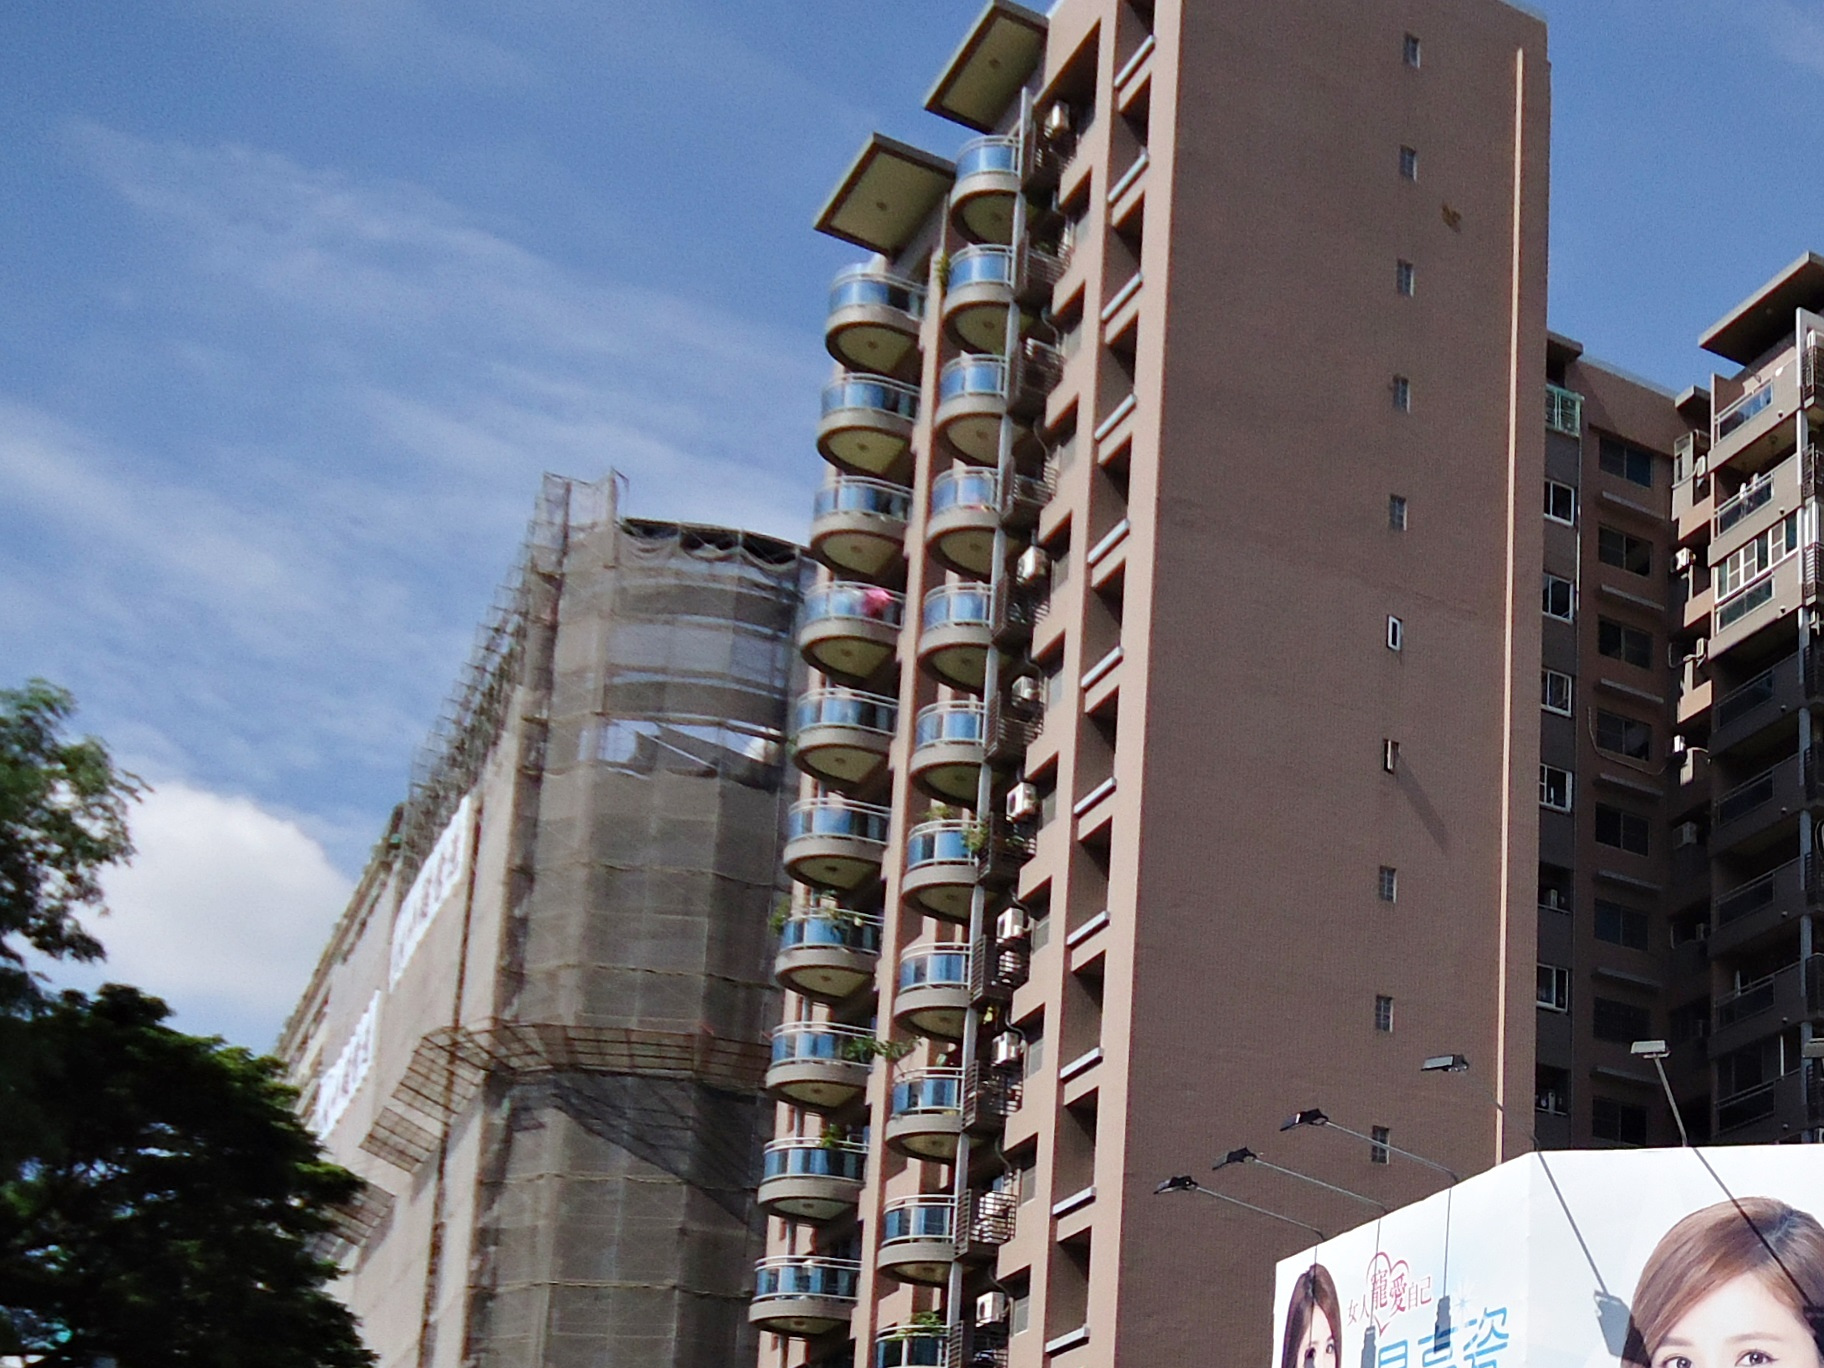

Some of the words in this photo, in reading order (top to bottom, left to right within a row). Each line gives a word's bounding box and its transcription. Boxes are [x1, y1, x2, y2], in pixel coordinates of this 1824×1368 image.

[1347, 1269, 1432, 1327] 女人寵愛自己
